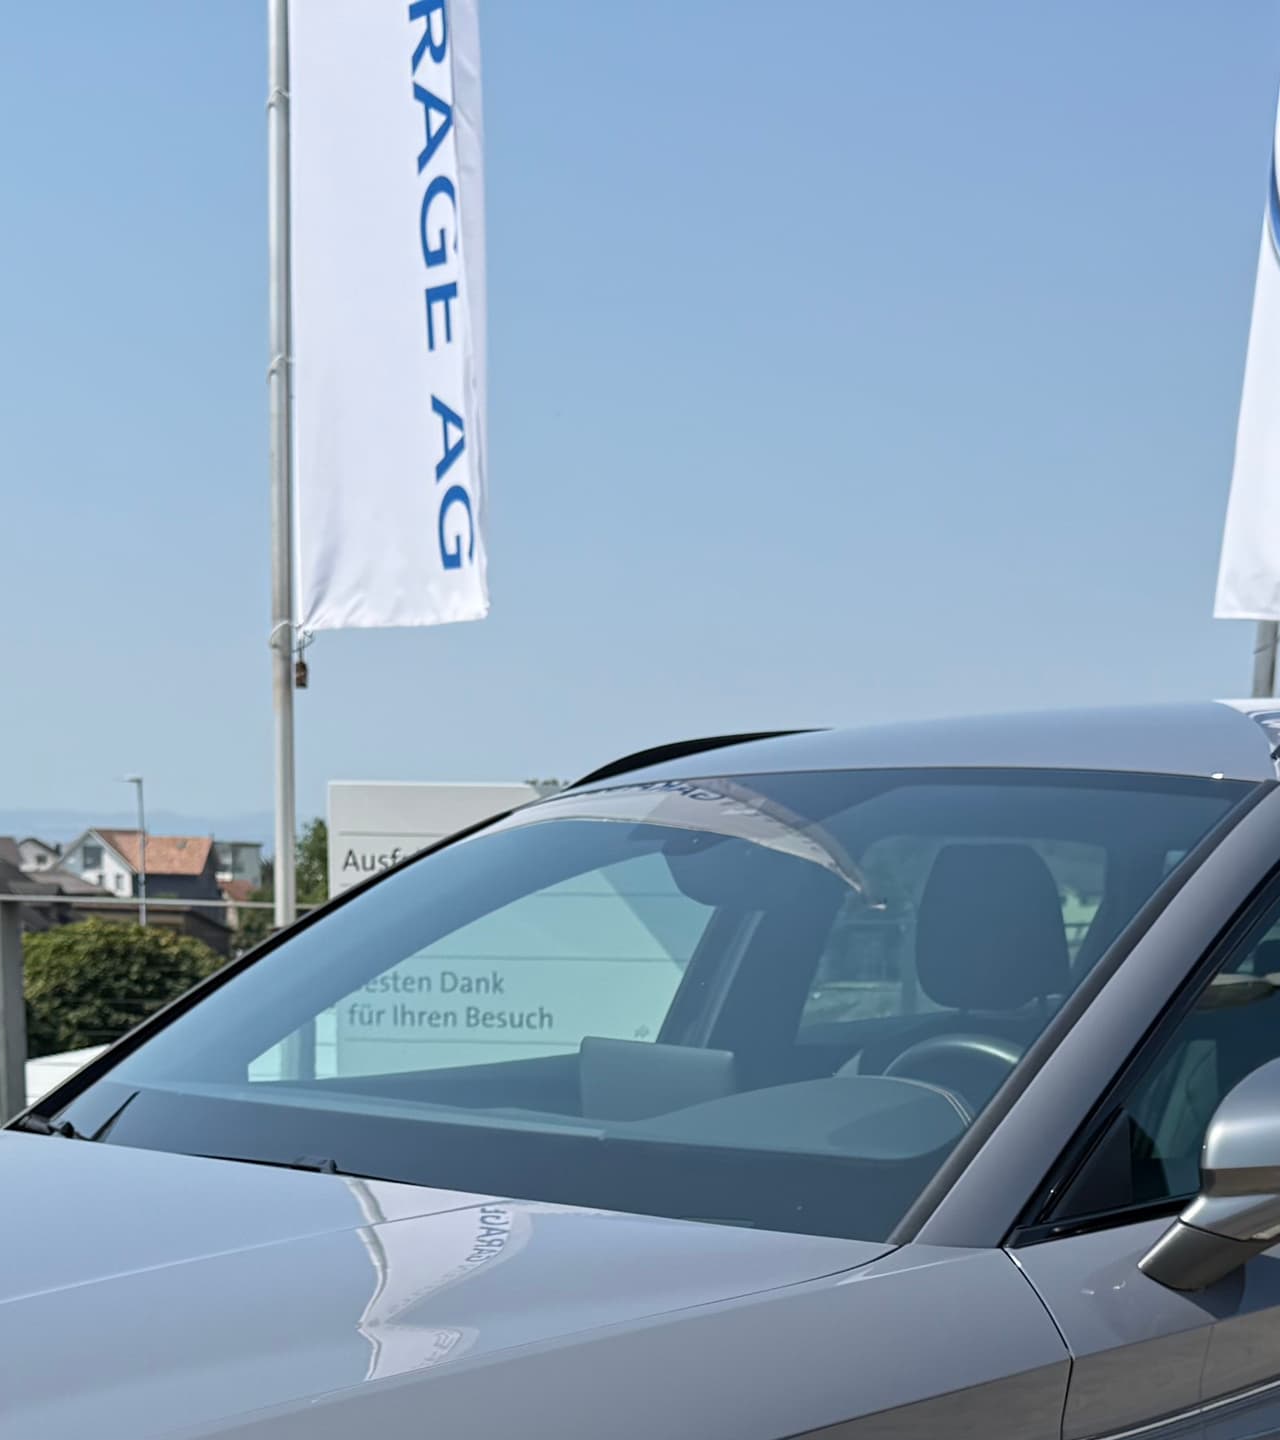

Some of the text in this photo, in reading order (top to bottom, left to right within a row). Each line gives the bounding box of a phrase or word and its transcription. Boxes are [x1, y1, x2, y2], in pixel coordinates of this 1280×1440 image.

[430, 394, 475, 571] AG
[342, 847, 410, 872] Ausf
[362, 971, 505, 995] esten Dank
[348, 1002, 554, 1030] für Ihren Besuch
